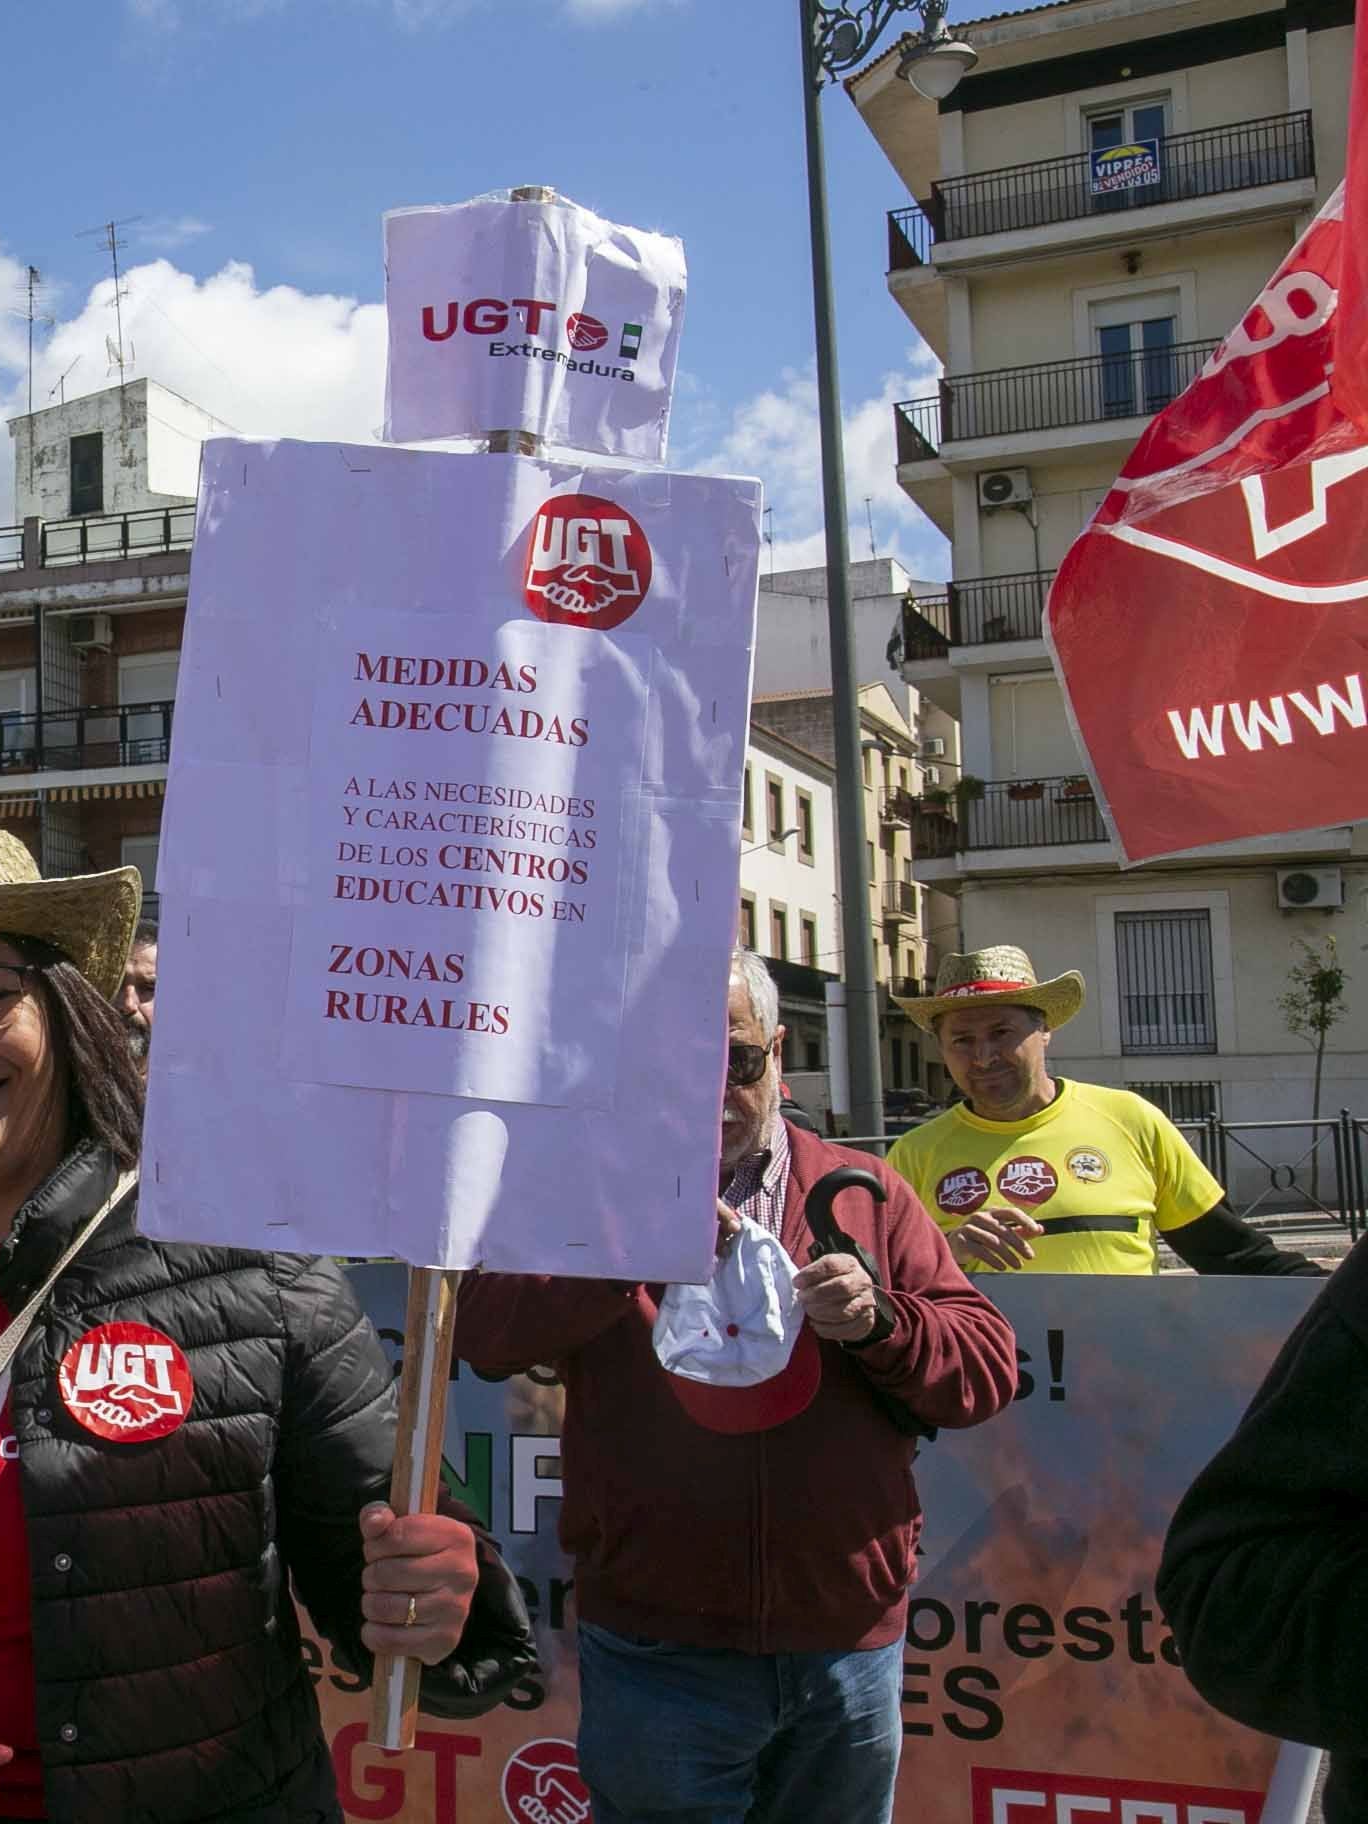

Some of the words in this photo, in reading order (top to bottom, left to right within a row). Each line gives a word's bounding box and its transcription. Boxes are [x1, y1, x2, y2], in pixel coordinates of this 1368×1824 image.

[422, 298, 557, 342] UGT
[488, 341, 635, 382] Extremadura
[532, 513, 633, 573] UGT
[352, 652, 538, 694] MEDIDAS
[348, 698, 590, 748] ADECUADAS
[343, 776, 362, 796] A
[367, 777, 417, 801] LAS
[423, 781, 596, 819] NECESIDADES
[342, 805, 360, 826] Y
[365, 808, 598, 849] CARACTERÍSTICAS
[337, 841, 374, 864] DE
[380, 846, 429, 867] LOS
[438, 844, 590, 885] CENTROS
[333, 874, 545, 918] EDUCATIVOS
[551, 900, 587, 923] EN
[327, 945, 466, 984] ZONAS
[323, 989, 511, 1035] RURALES
[943, 1171, 979, 1194] UGT
[1007, 1162, 1045, 1179] UGT
[73, 1342, 176, 1395] UGT
